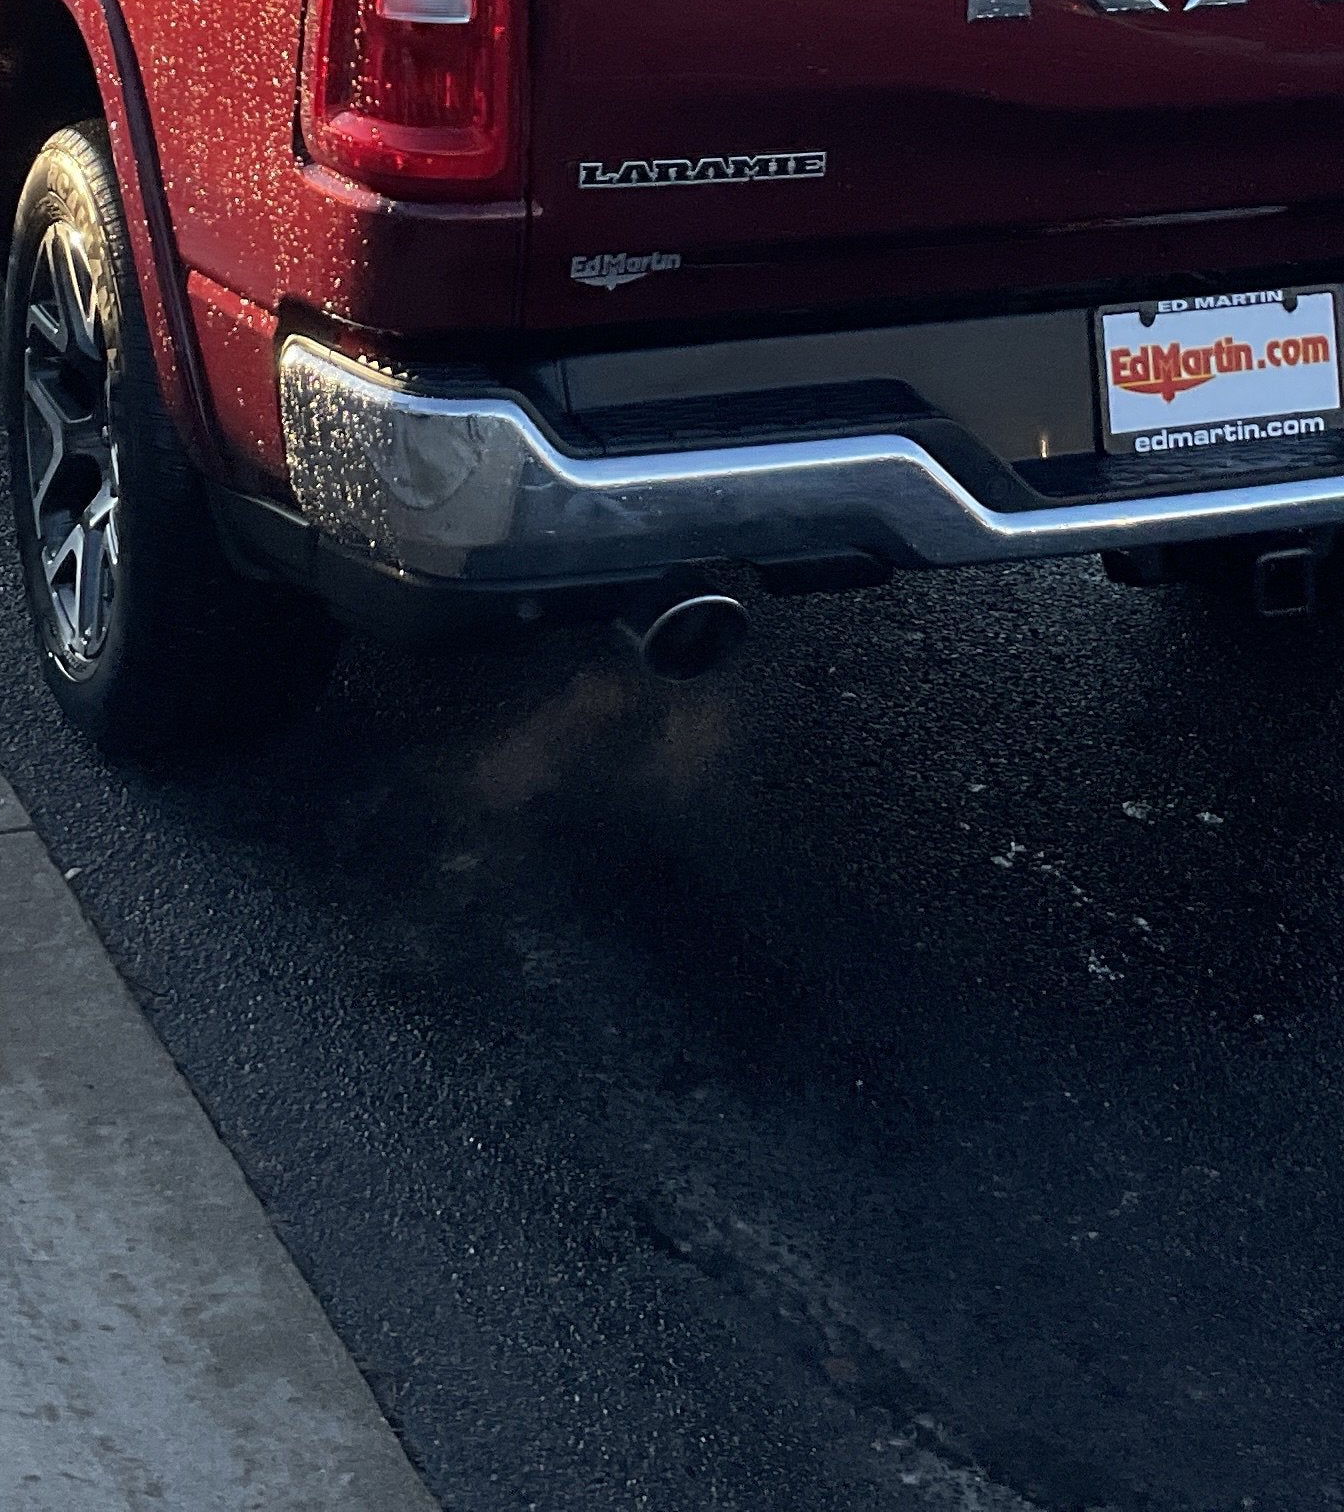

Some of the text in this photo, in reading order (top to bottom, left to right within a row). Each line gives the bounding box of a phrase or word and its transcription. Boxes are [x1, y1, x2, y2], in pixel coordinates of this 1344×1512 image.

[578, 151, 827, 188] LARAMIE
[1157, 289, 1283, 313] ED MARTIN
[1134, 416, 1325, 453] edmartin.com
